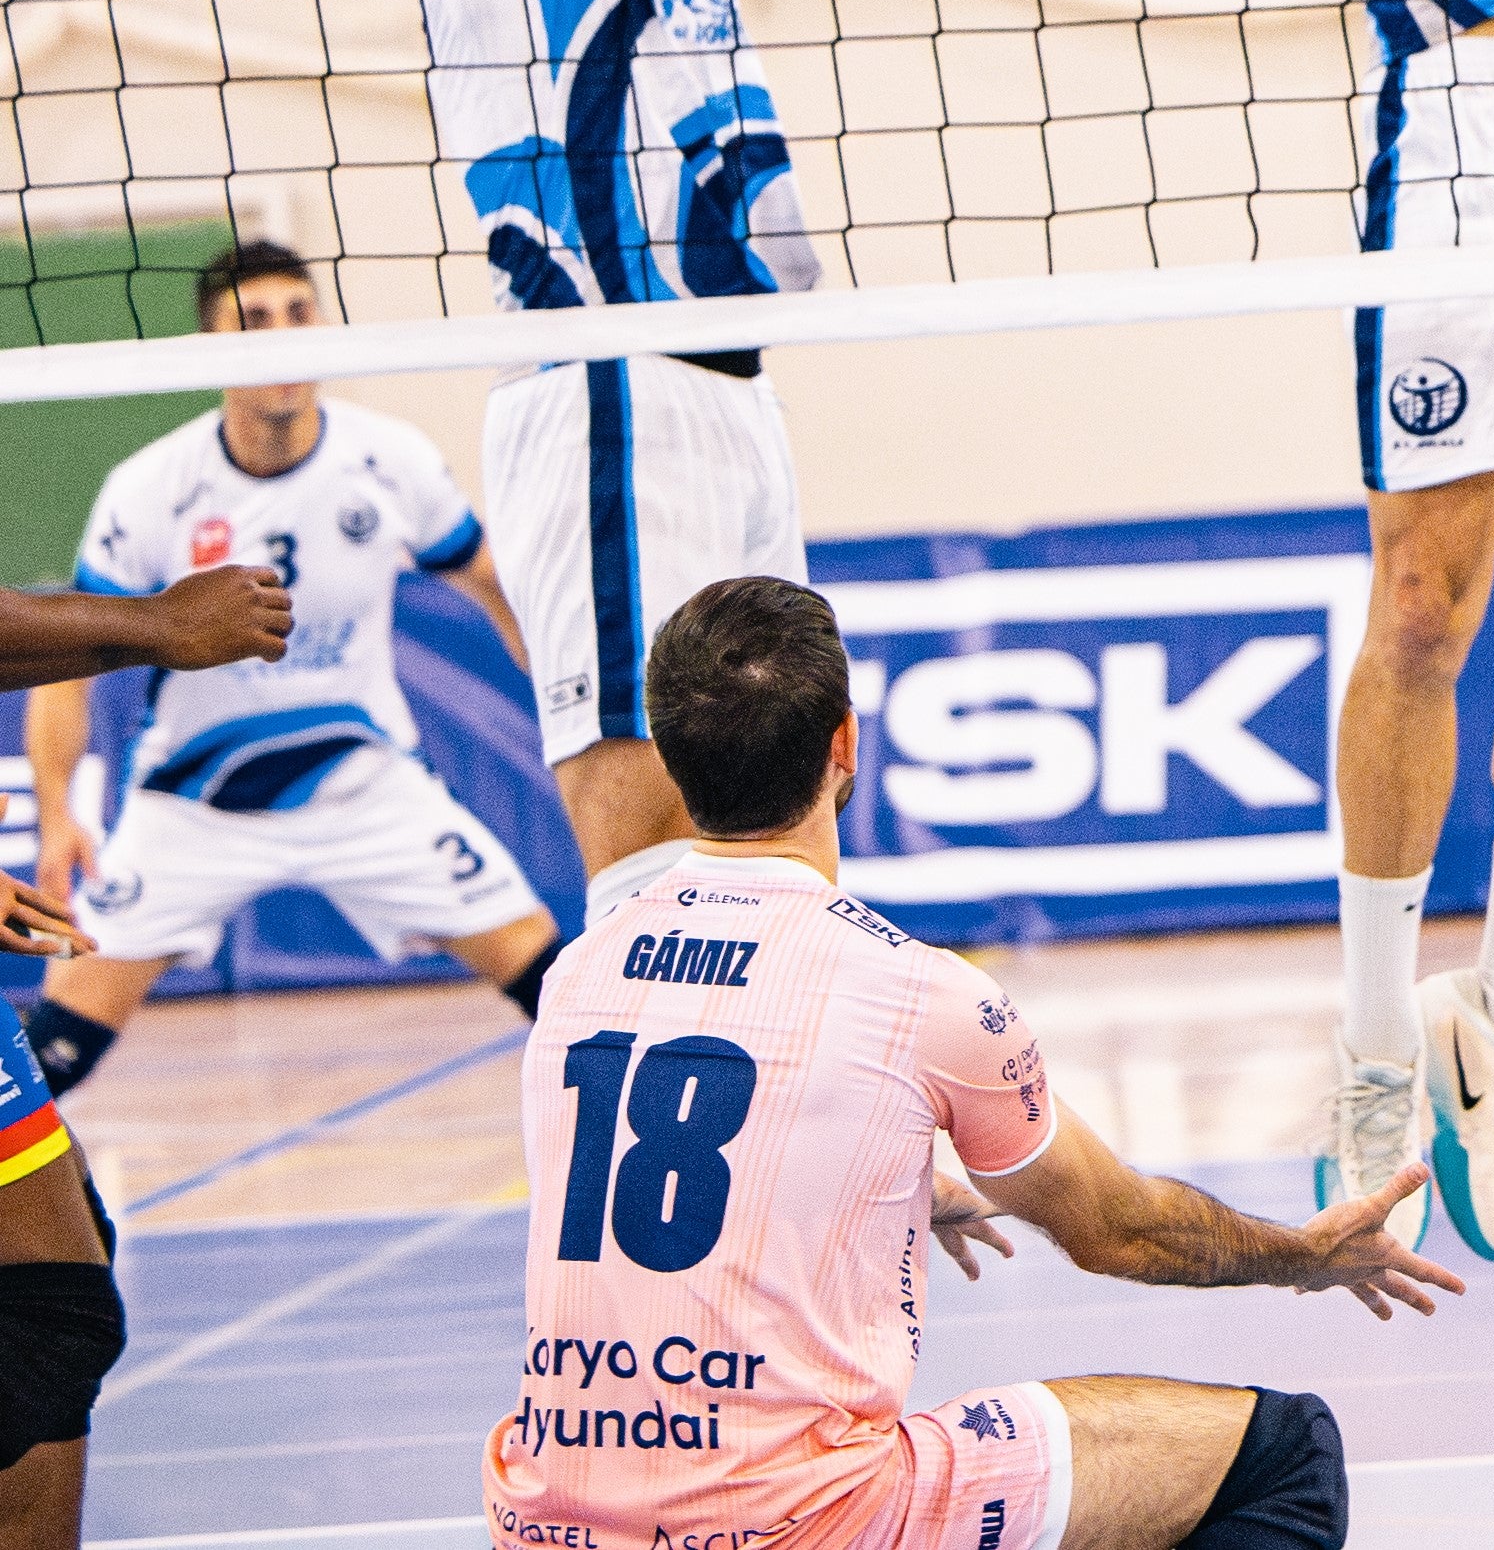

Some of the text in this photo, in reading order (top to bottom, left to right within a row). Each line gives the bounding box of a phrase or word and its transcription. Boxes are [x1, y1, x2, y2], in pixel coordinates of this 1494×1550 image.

[433, 831, 487, 883] 3
[700, 892, 761, 906] LÉLEMAN
[842, 899, 904, 940] TSK
[622, 929, 760, 988] GÁMIZ
[557, 1029, 758, 1273] 18
[652, 1336, 766, 1390] Car
